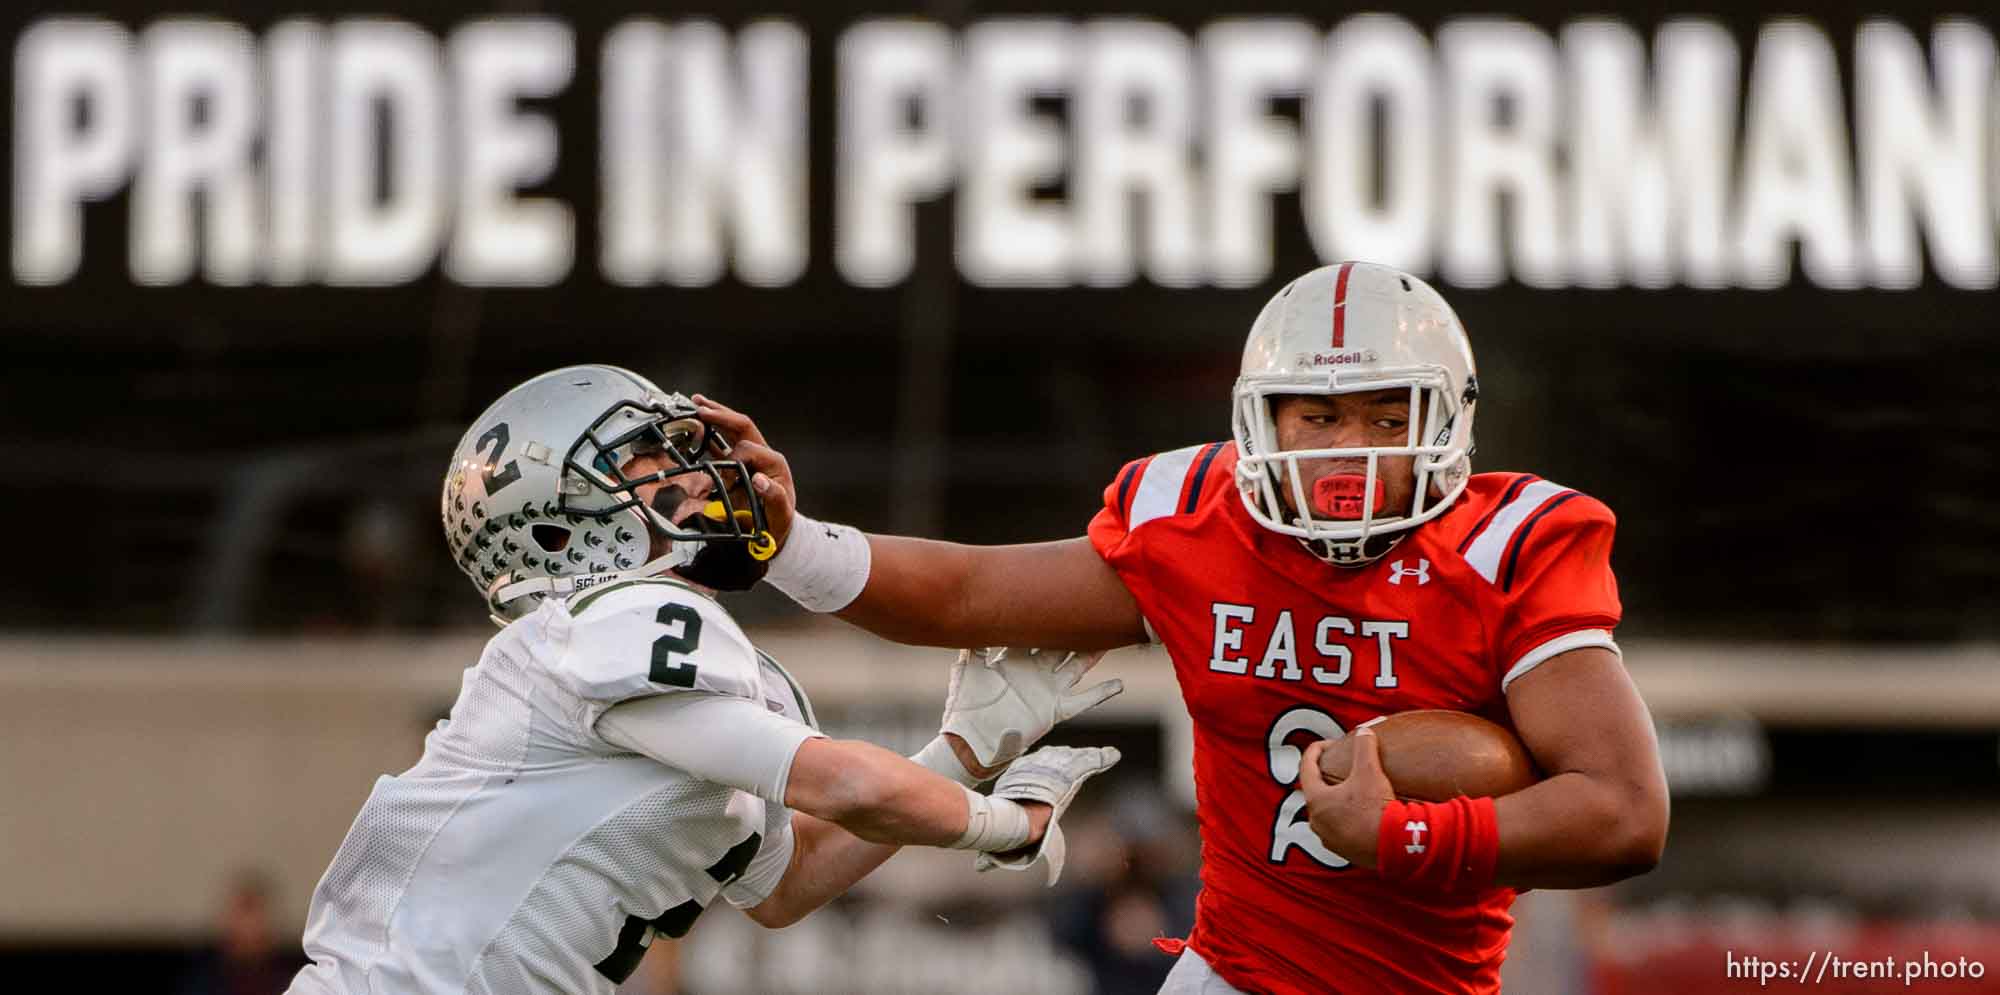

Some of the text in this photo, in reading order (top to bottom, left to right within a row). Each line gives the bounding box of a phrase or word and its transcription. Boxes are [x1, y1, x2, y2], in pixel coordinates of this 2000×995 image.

[12, 13, 2000, 290] PRIDE IN PERFORMAN
[1314, 352, 1361, 366] Riddell
[476, 422, 521, 496] 2
[650, 602, 703, 688] 2
[1208, 602, 1409, 689] EAST
